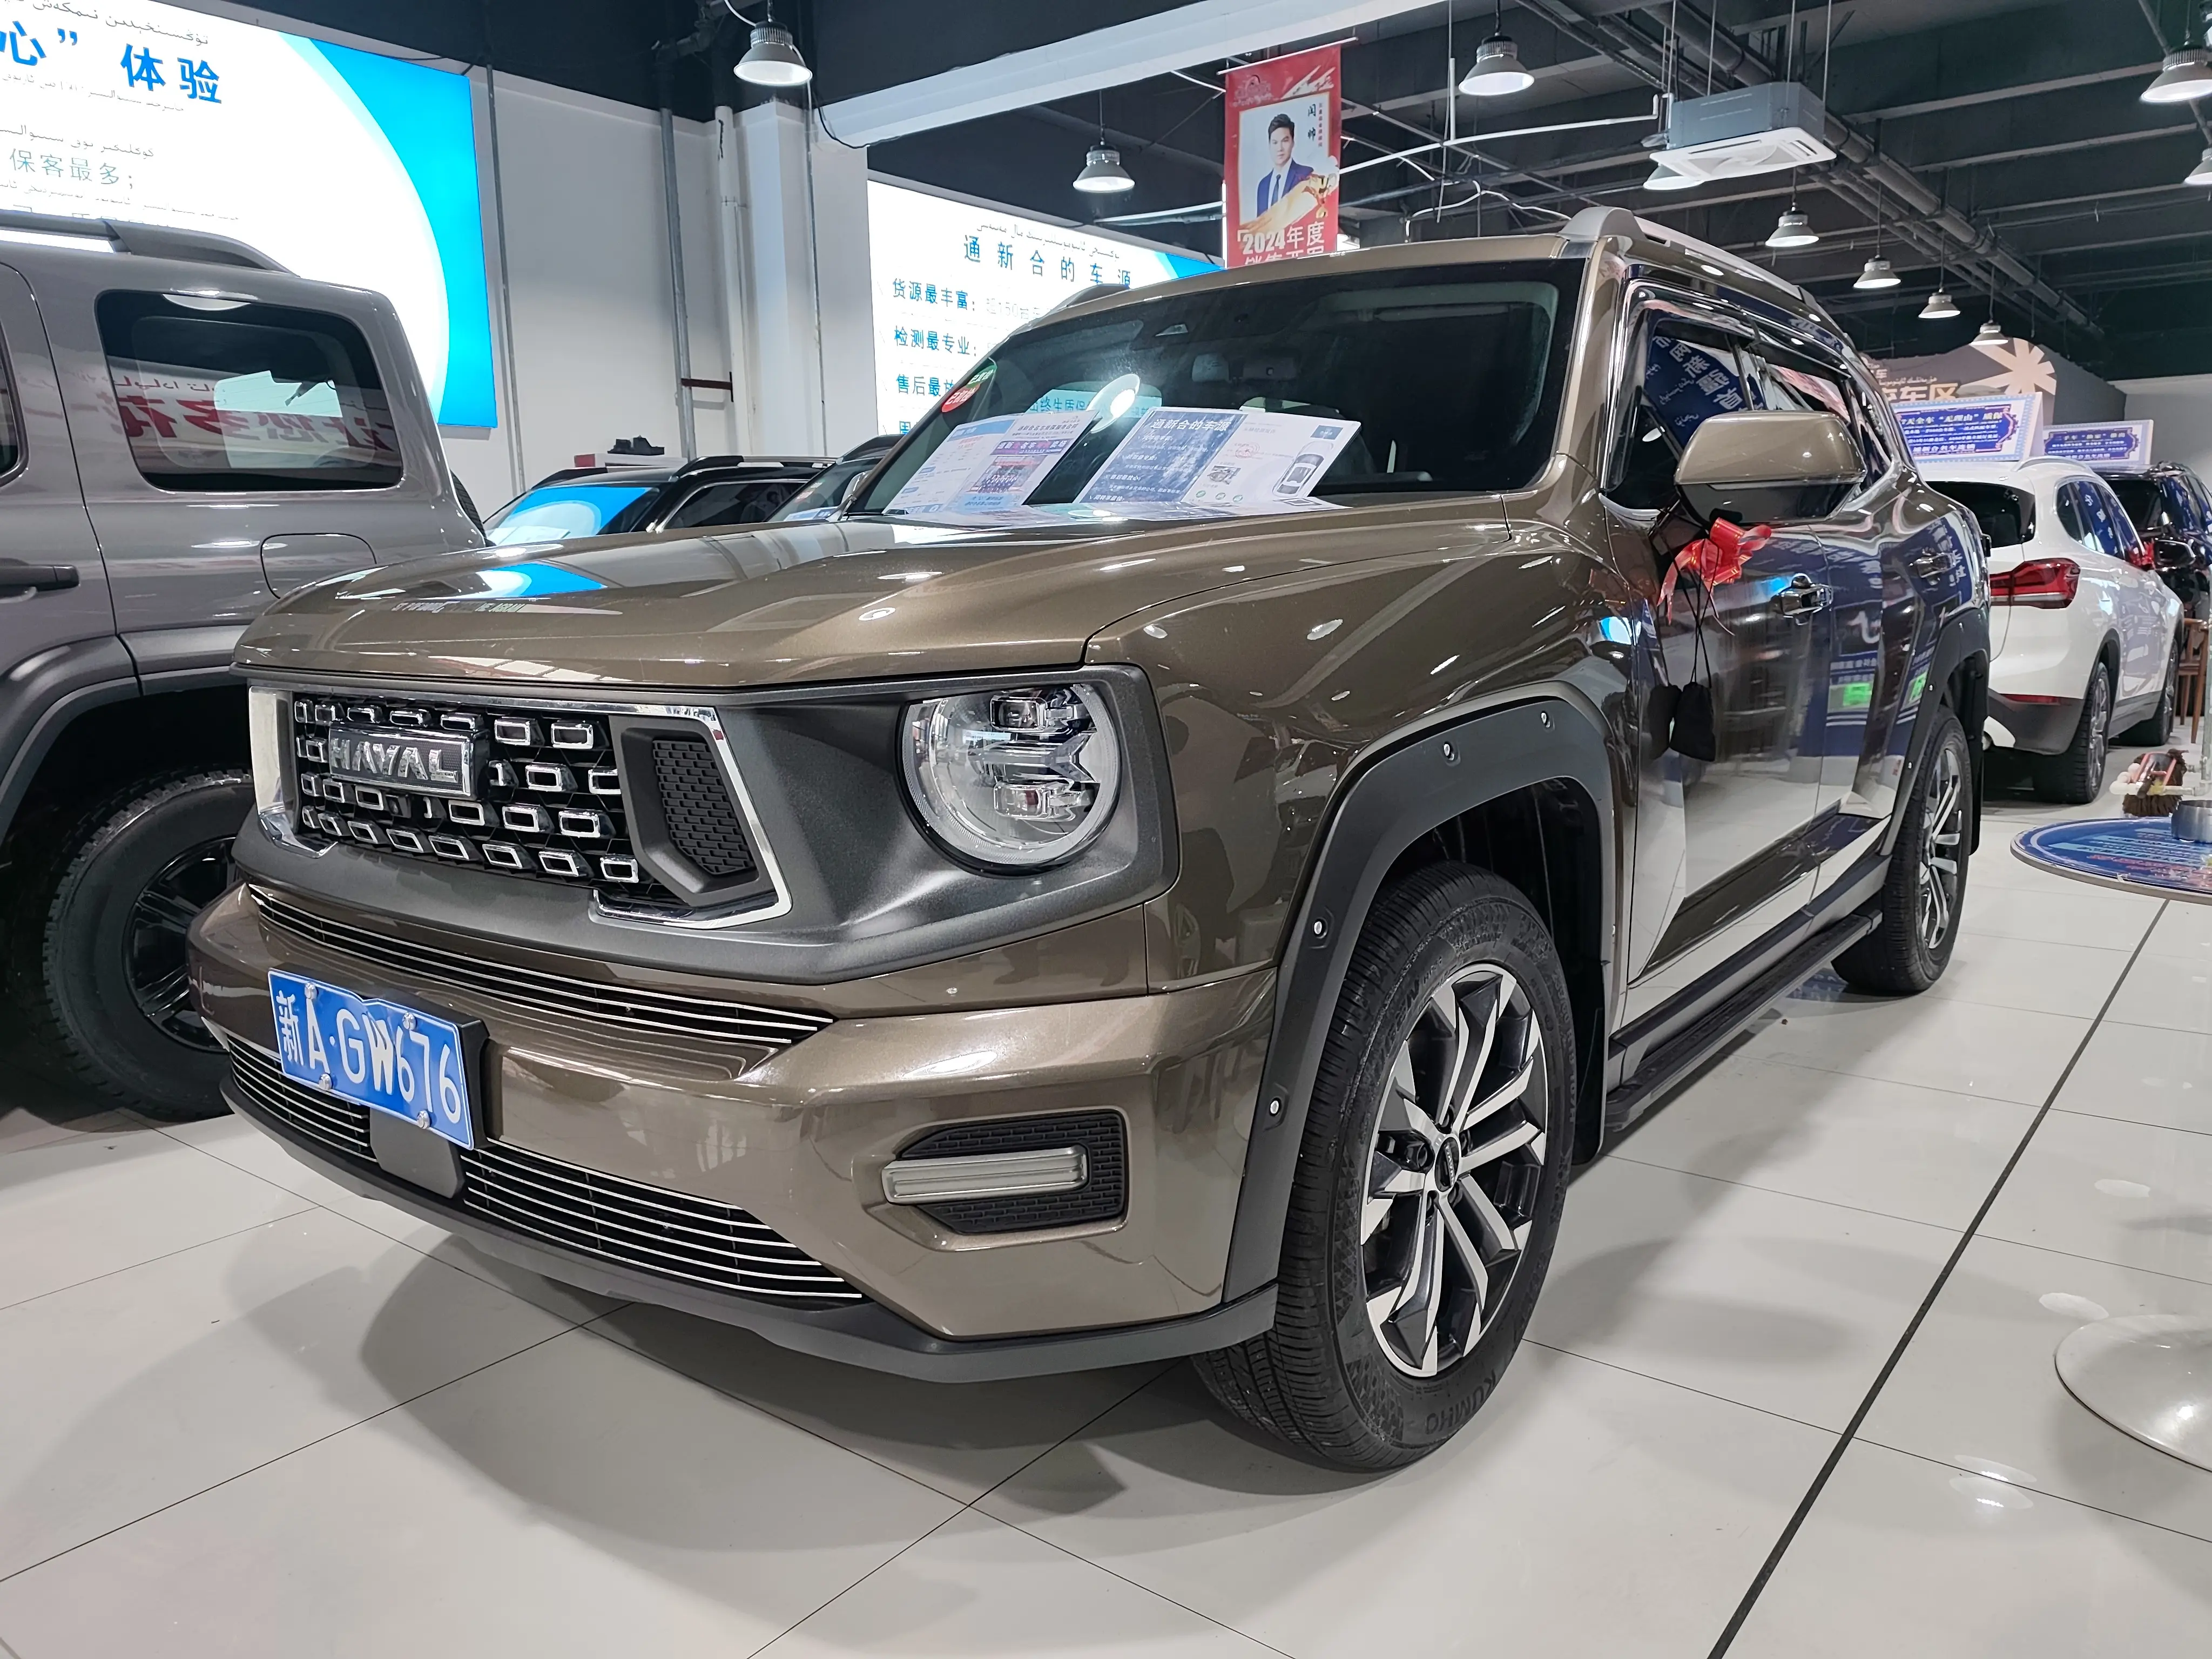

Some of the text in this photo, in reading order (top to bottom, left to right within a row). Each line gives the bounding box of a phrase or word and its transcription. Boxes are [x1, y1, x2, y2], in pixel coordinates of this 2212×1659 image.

[120, 43, 222, 104] 体验
[963, 234, 1131, 286] 通新合的车源
[1150, 418, 1232, 431] 通新合的车源
[328, 730, 460, 782] HAVAL
[1425, 1368, 1496, 1435] KUMHO
